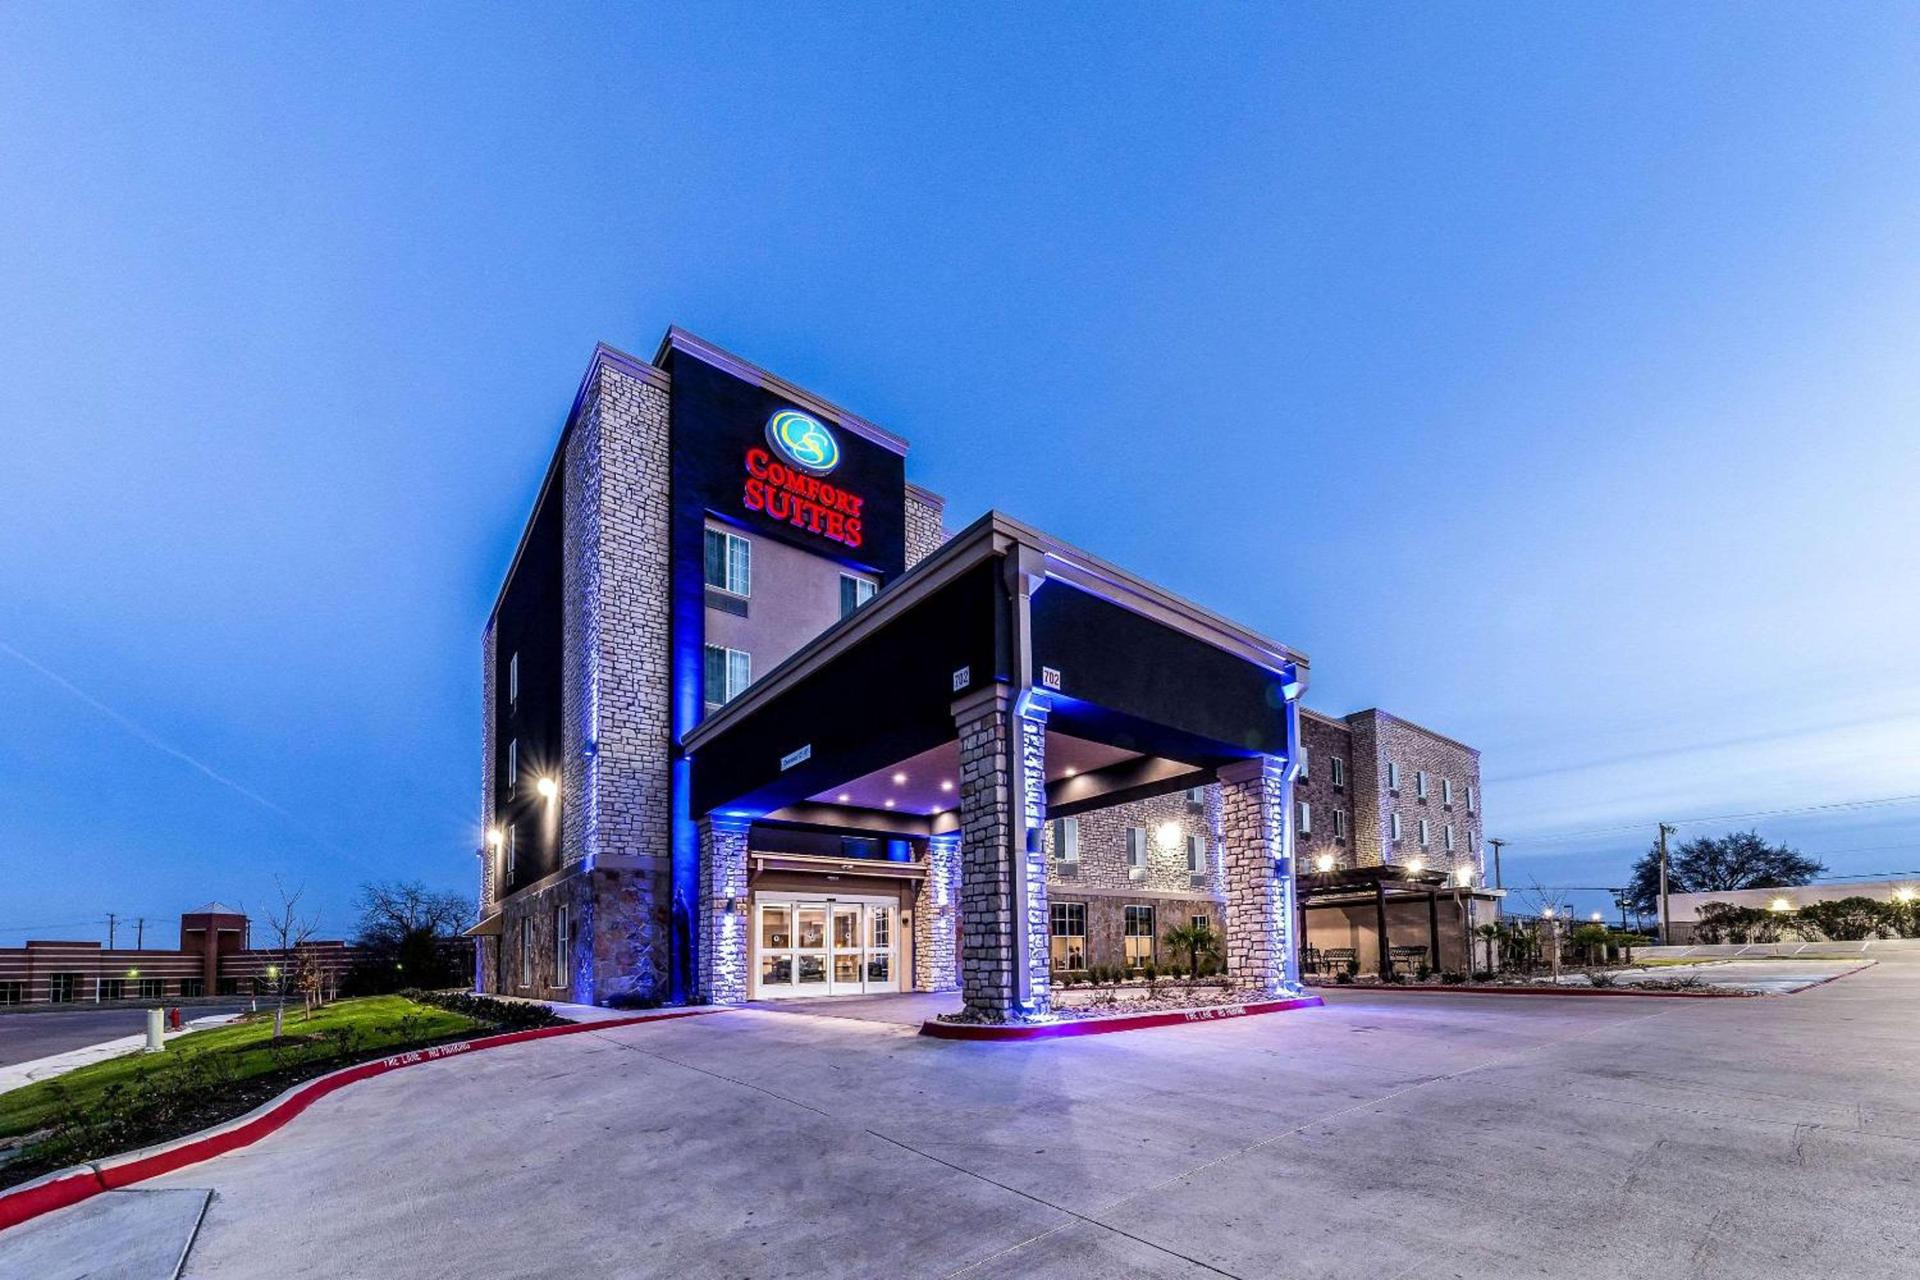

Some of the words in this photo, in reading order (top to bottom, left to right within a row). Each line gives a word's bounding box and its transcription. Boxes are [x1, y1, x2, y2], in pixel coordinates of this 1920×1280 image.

[743, 478, 863, 548] SUITES
[745, 448, 864, 517] COMFORT
[1044, 670, 1060, 686] 702
